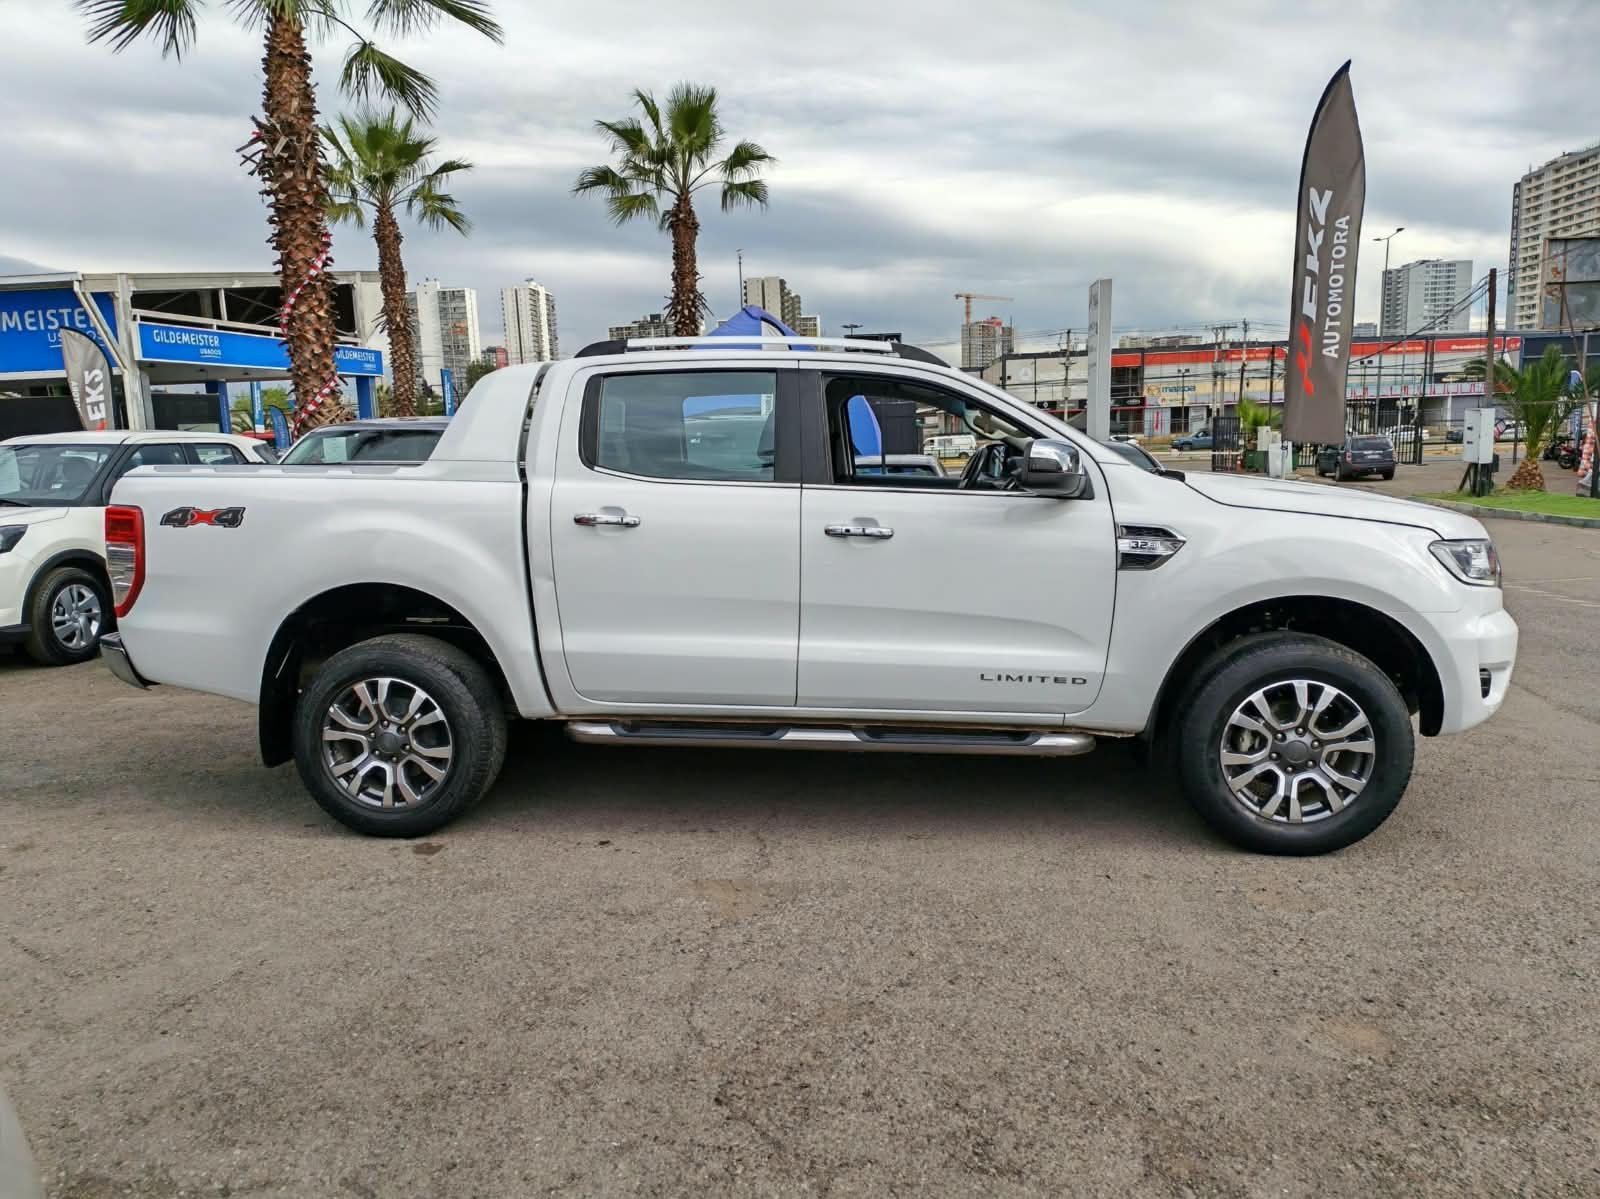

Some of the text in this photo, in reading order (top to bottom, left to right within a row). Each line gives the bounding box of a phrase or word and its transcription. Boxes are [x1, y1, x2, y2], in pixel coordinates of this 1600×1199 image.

[1509, 186, 1521, 281] ARRIENDOS
[1322, 216, 1350, 358] AUTOMOTORA
[1, 308, 96, 332] MEISTE
[153, 328, 220, 347] GILDEMEISTER
[980, 673, 1087, 685] LIMITED
